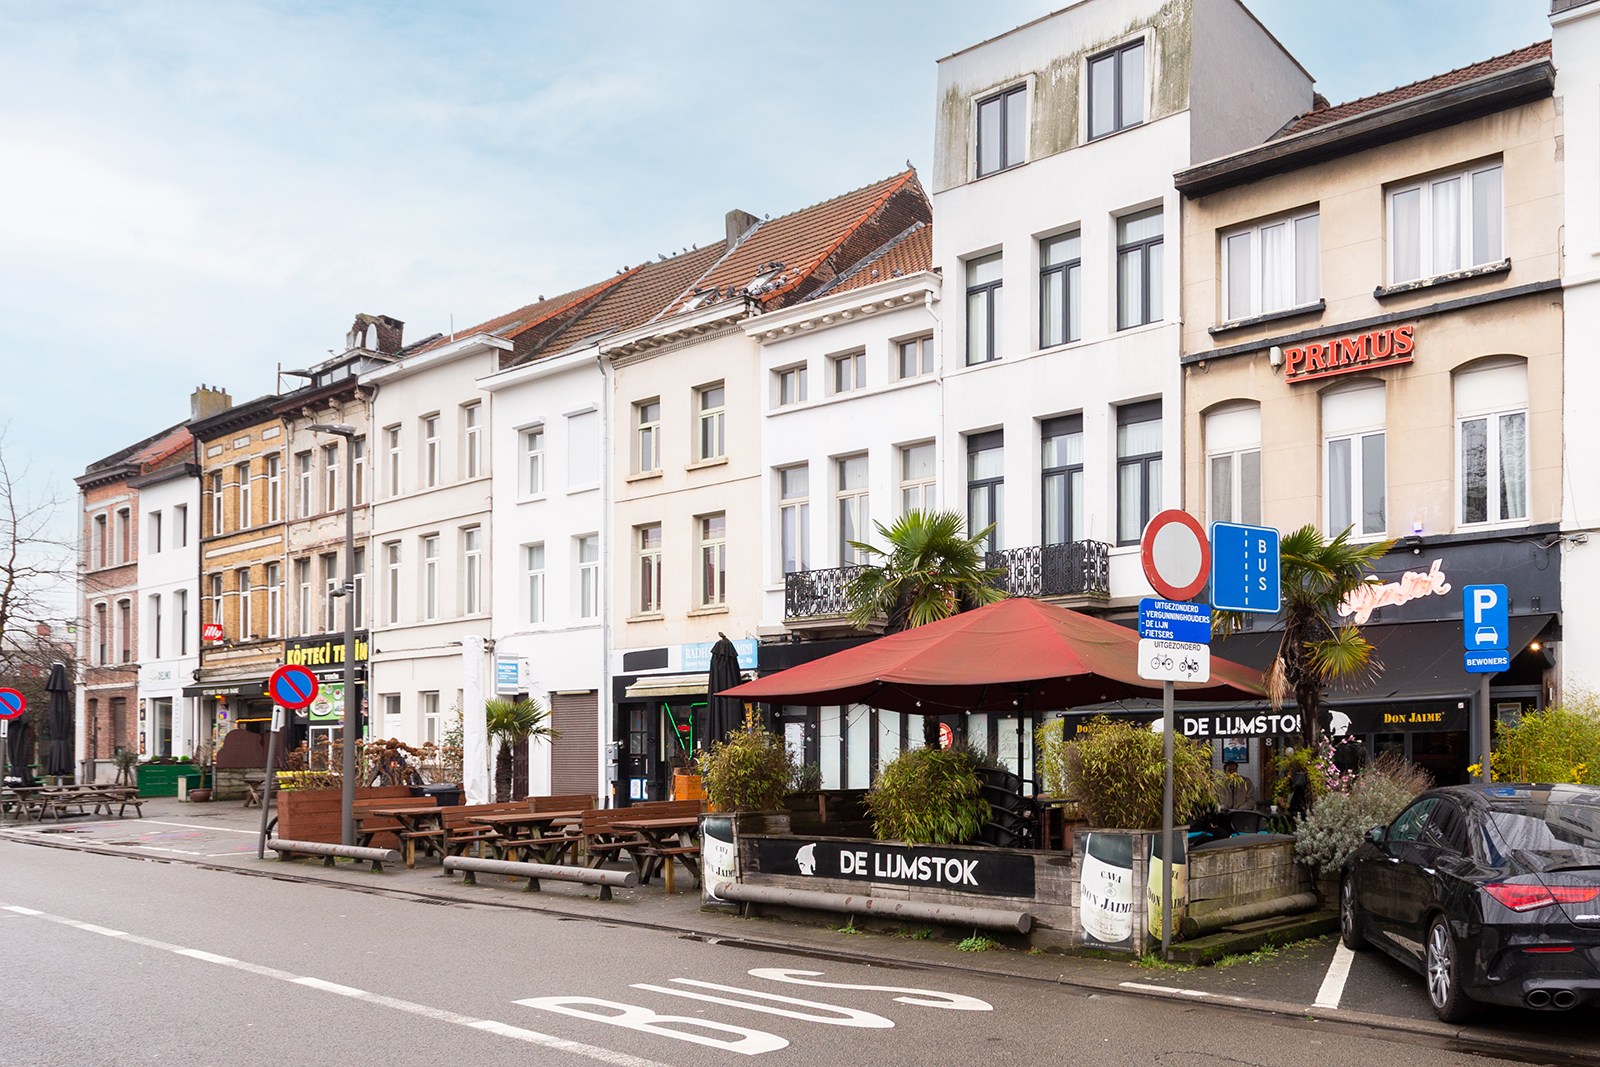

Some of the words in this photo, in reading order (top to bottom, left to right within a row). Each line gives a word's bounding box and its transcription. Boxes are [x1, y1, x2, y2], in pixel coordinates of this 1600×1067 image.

[1283, 325, 1415, 375] PRIMUS
[1257, 539, 1268, 591] BUS
[1154, 601, 1199, 613] UITGEZONDERD
[1473, 589, 1497, 624] P
[1145, 610, 1210, 624] VERGUNNINGHOUDERS
[1145, 620, 1154, 628] DE
[1154, 621, 1169, 629] LIJN
[204, 625, 222, 639] illy
[1145, 630, 1174, 639] FIETSERS
[333, 639, 368, 663] TEİN
[1154, 641, 1201, 652] UITGEZONDERD
[1466, 657, 1508, 667] BEWONERS
[1384, 713, 1406, 723] DON
[1409, 712, 1442, 723] JAIME
[1184, 717, 1209, 736] DE
[1265, 738, 1273, 746] 8
[839, 850, 868, 876] DE
[874, 852, 980, 886] LIJMSTOK
[1100, 870, 1122, 884] CAVA
[511, 967, 993, 1056] BUS
